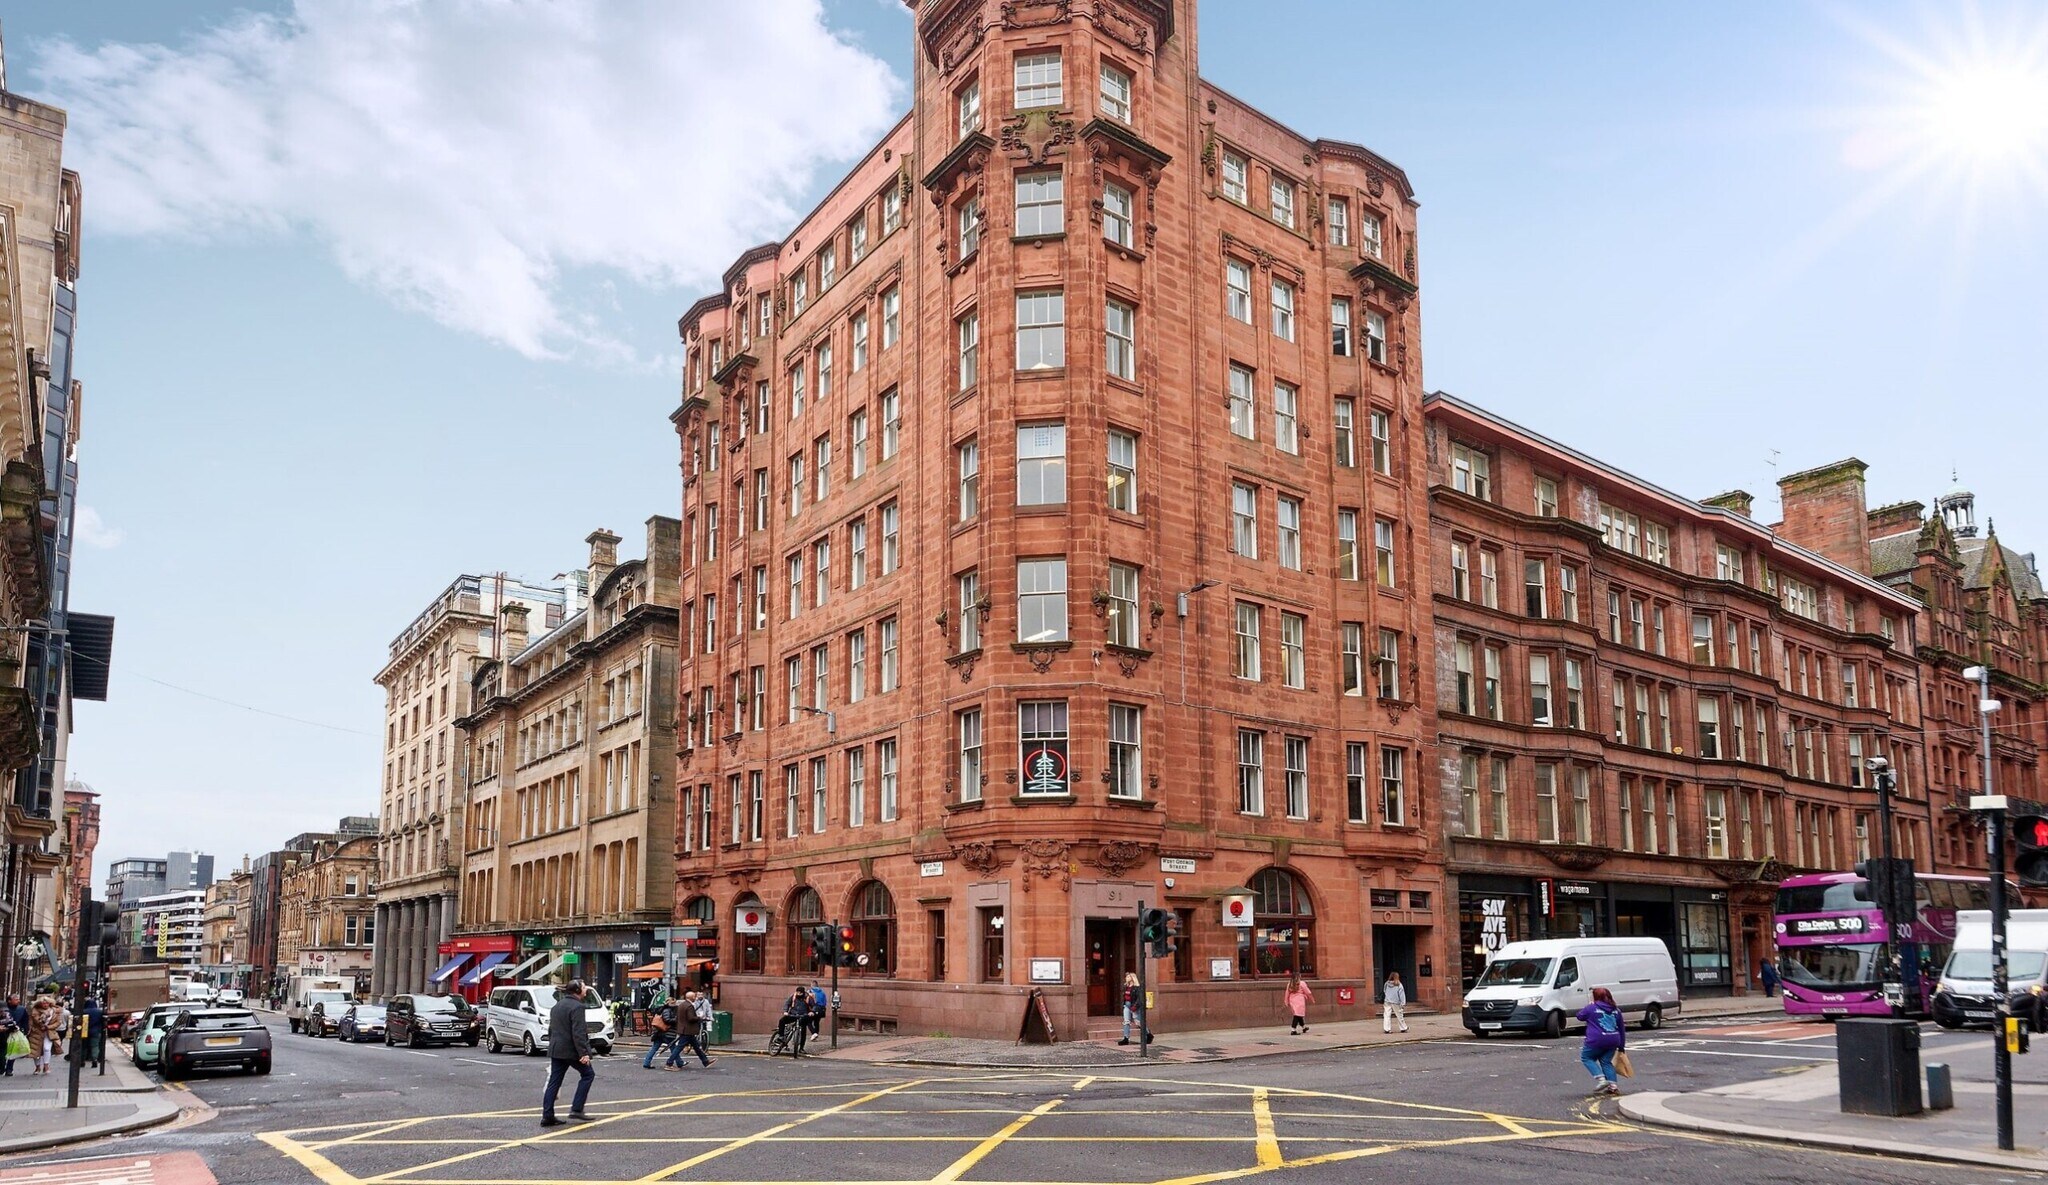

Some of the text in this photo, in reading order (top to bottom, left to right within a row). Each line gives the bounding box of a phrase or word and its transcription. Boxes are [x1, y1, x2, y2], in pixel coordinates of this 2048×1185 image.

[1108, 890, 1123, 901] 91
[1560, 885, 1590, 895] wagamama
[1482, 899, 1506, 916] SAY
[1483, 916, 1506, 933] AYE
[1839, 917, 1862, 930] 500
[1481, 933, 1507, 949] TO A
